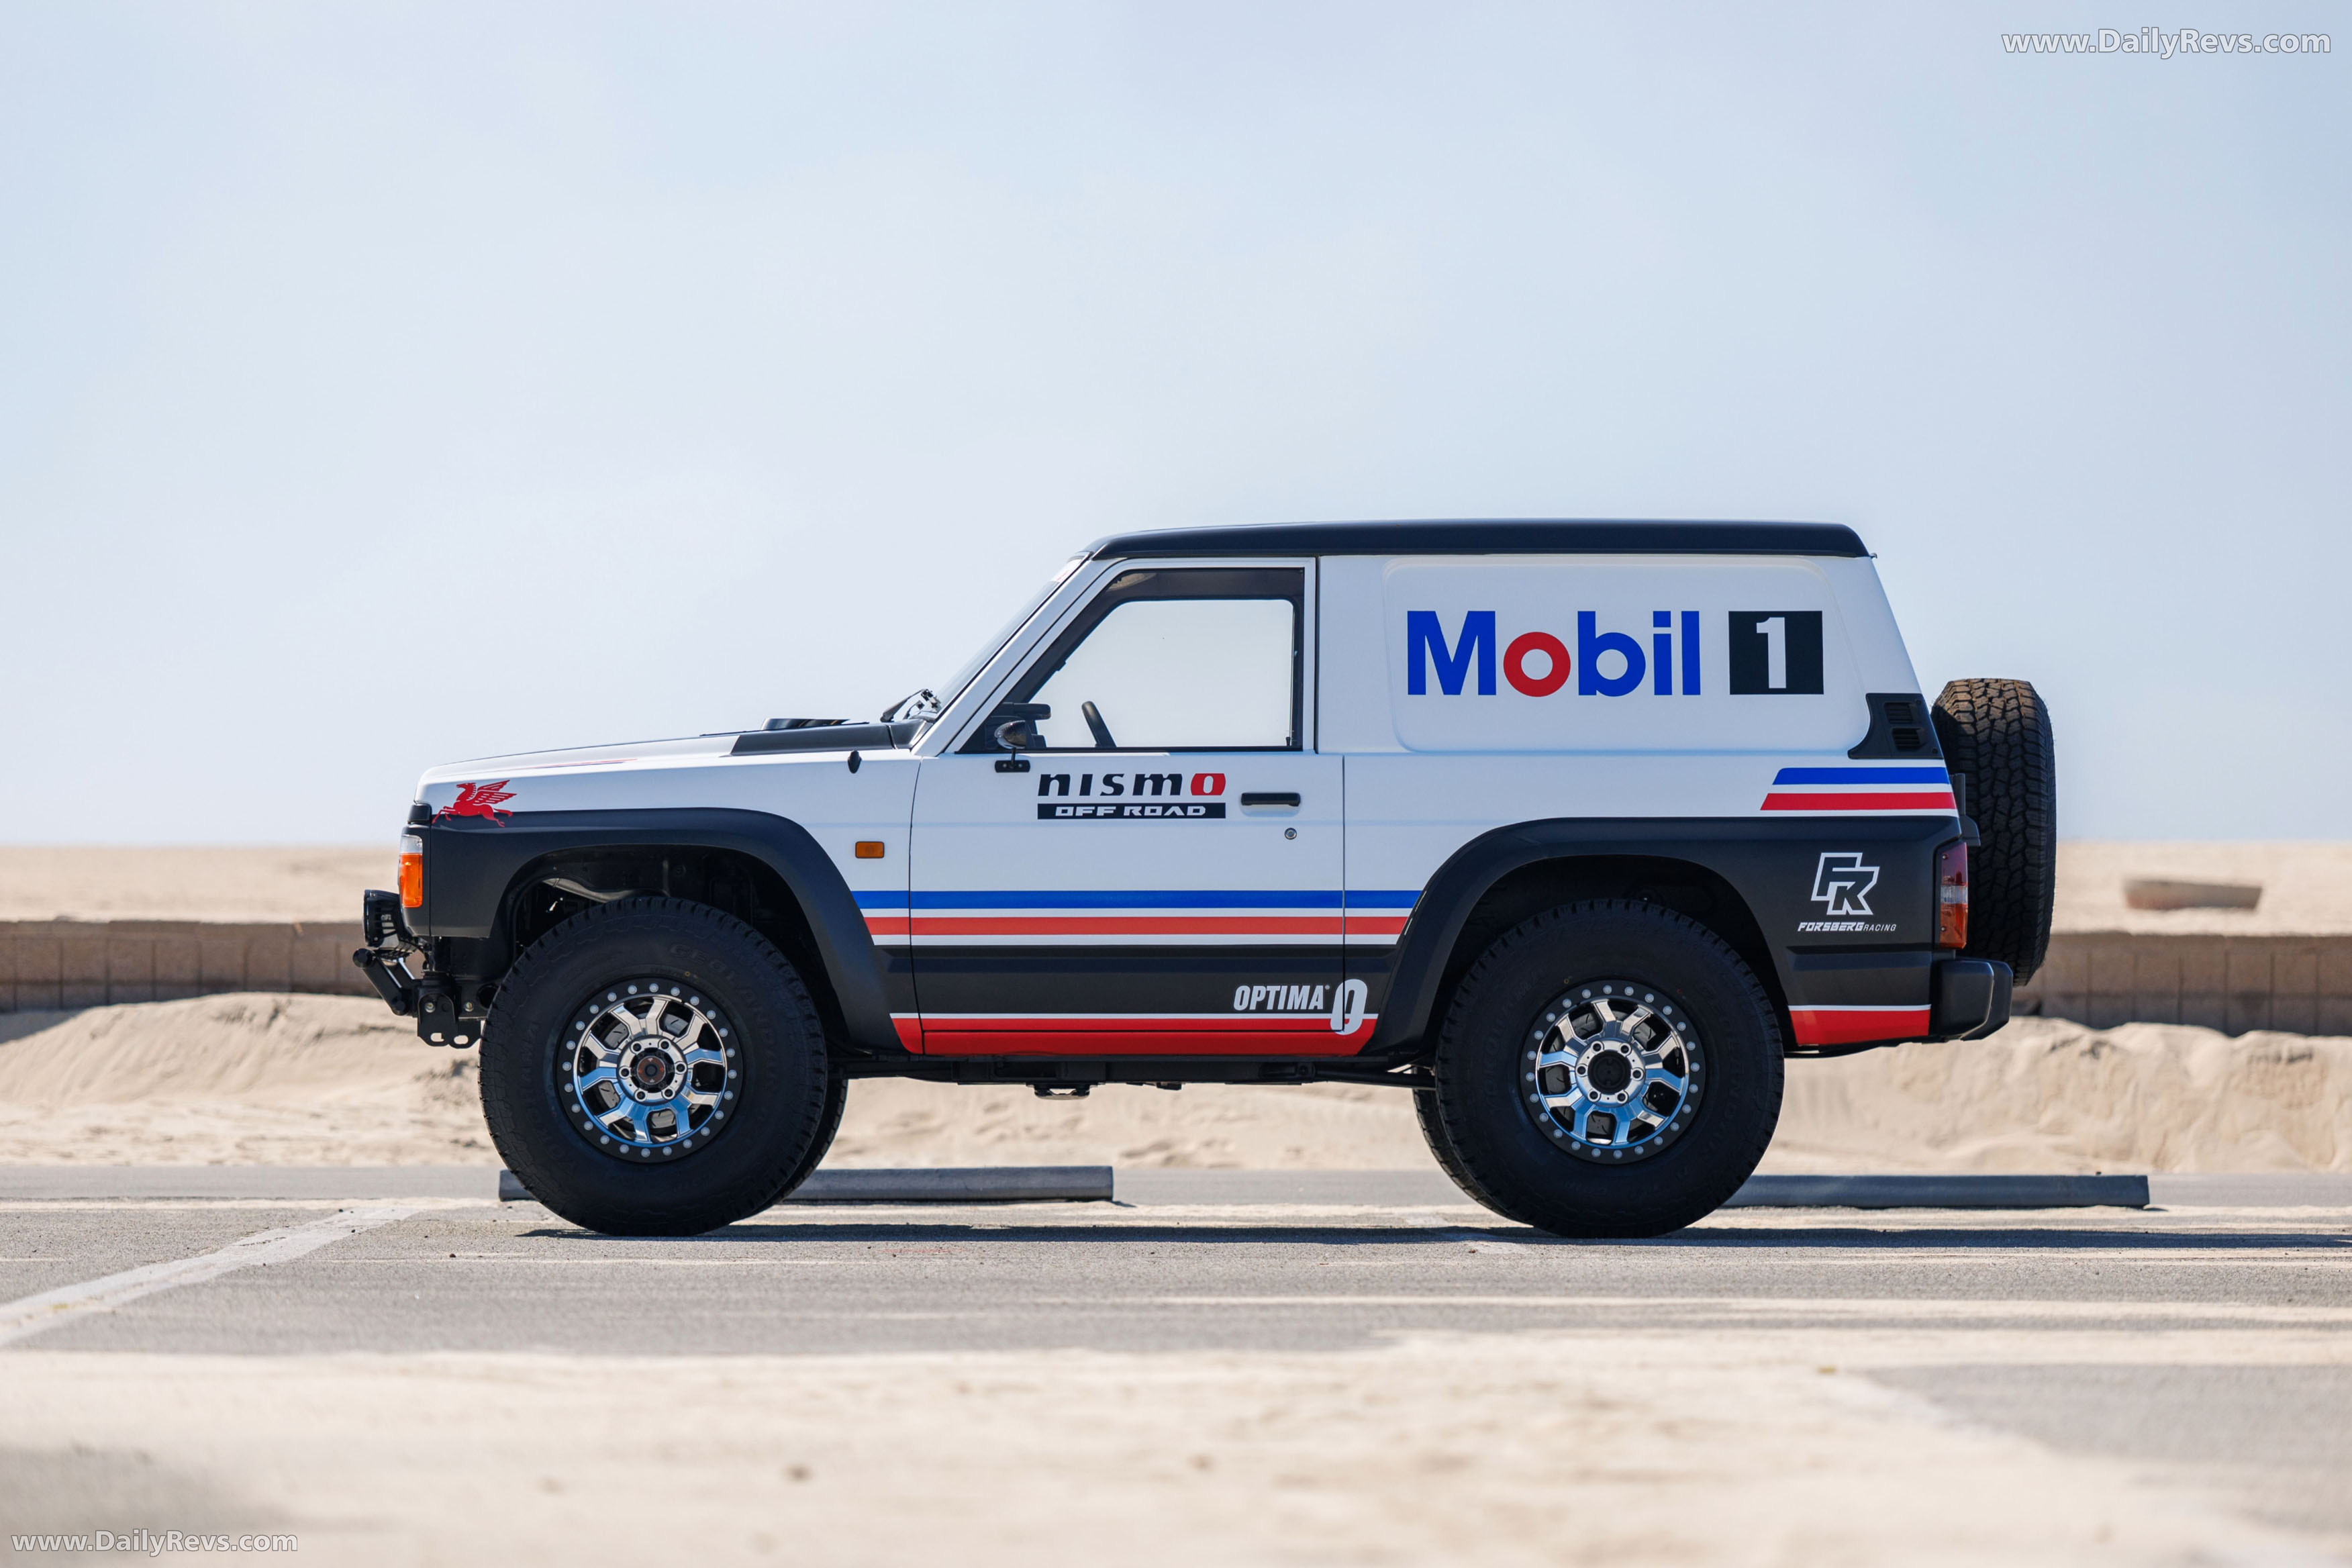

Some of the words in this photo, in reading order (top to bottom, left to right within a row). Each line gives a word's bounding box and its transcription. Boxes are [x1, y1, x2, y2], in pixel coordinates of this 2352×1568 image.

[1407, 610, 1701, 697] Mobil
[1055, 807, 1117, 817] OFF
[1123, 806, 1206, 816] ROAD
